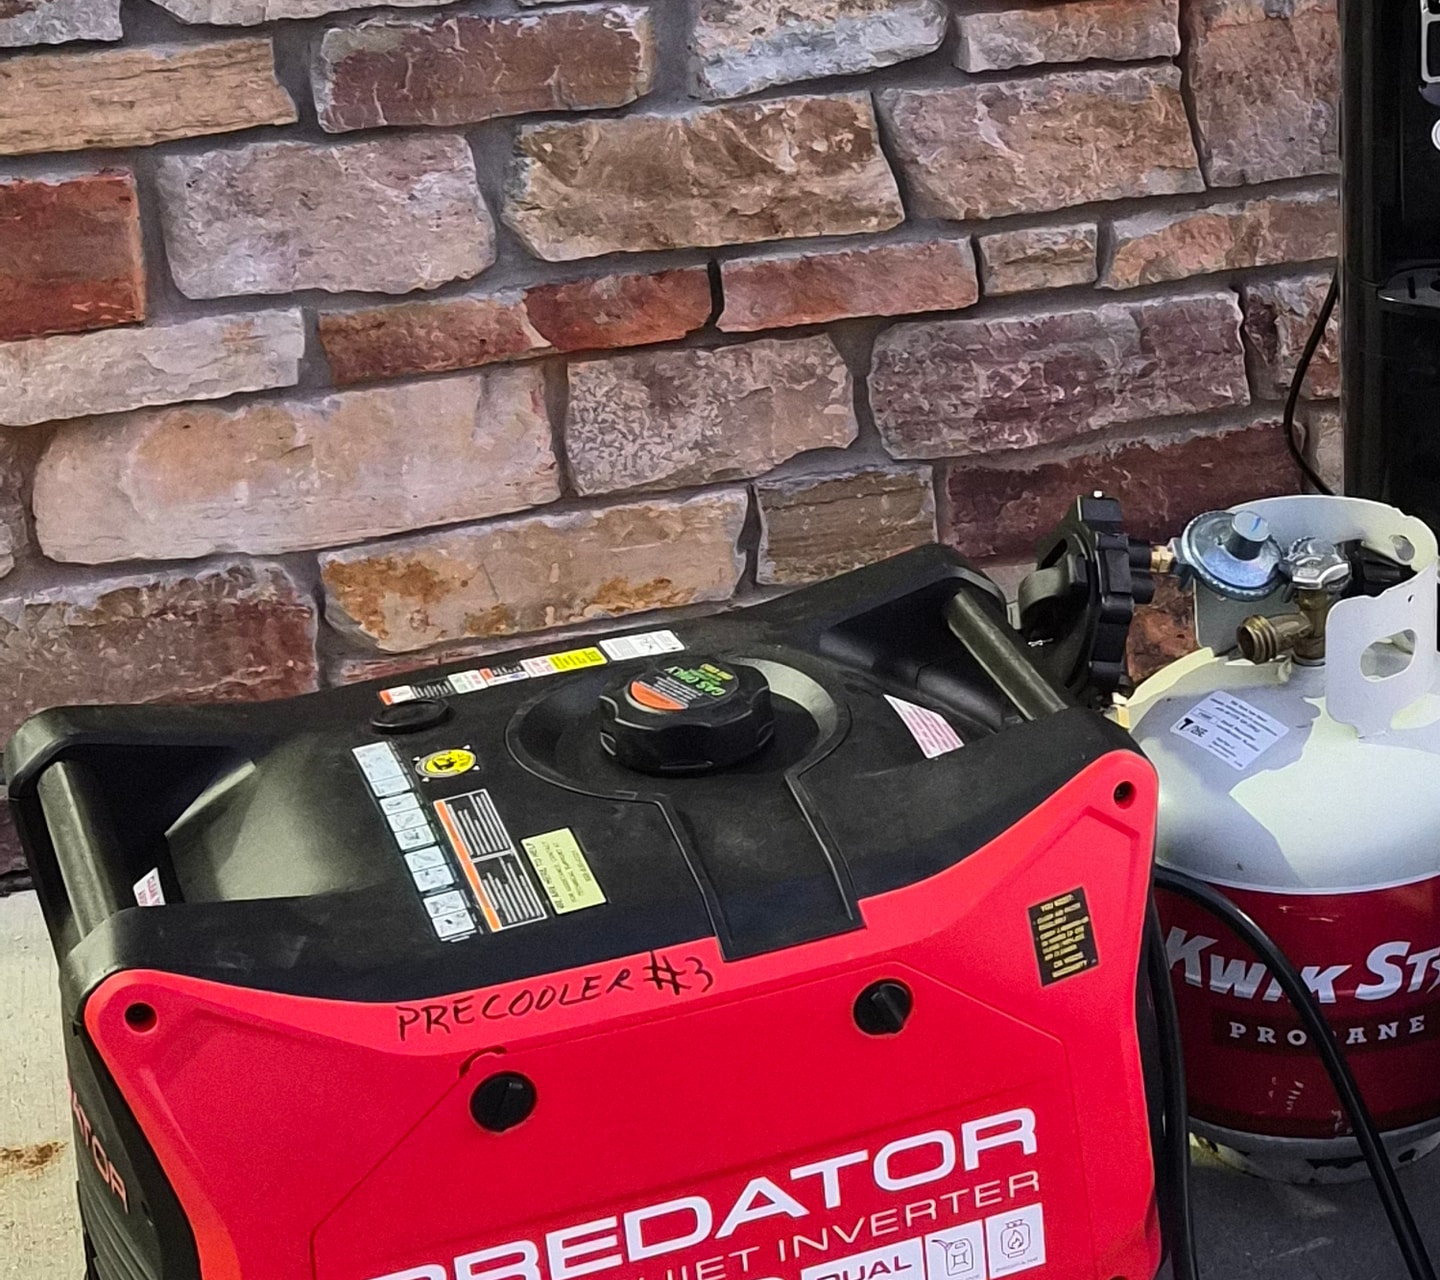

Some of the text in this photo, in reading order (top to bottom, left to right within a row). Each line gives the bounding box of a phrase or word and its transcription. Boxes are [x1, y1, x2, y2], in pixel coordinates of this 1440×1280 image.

[395, 950, 714, 1041] PRECOOLER #3
[1229, 1015, 1425, 1047] PROANE
[778, 1170, 1040, 1262] INVERTER
